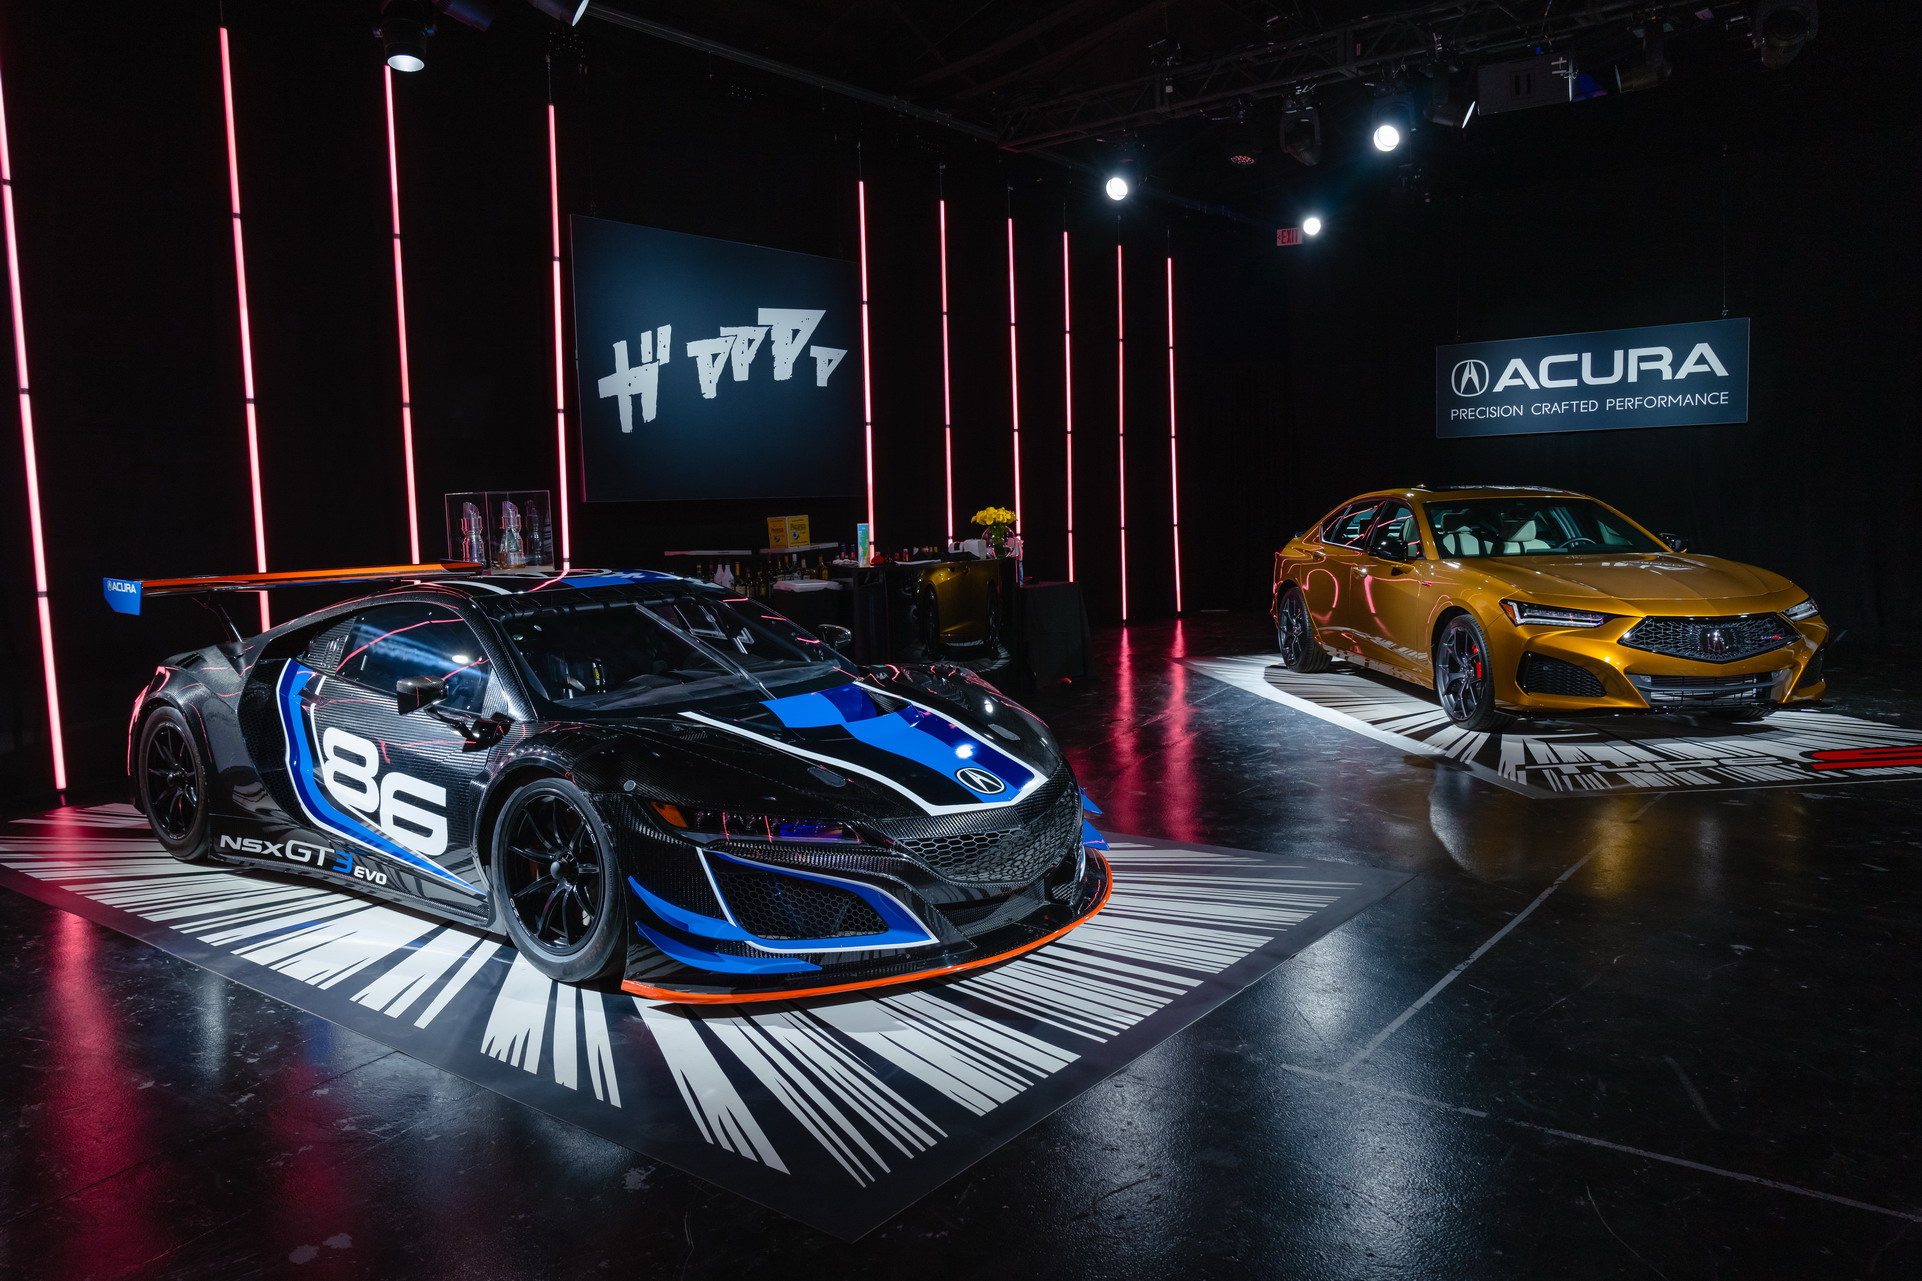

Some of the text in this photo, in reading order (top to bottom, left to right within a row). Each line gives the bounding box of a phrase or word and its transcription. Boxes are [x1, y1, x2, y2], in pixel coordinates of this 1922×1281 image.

[1492, 342, 1729, 393] ACURA
[1450, 391, 1729, 421] PRECISION CRAFTED PERFORMANCE
[112, 581, 137, 594] ACURA
[323, 727, 448, 856] 86
[354, 866, 387, 886] EVO
